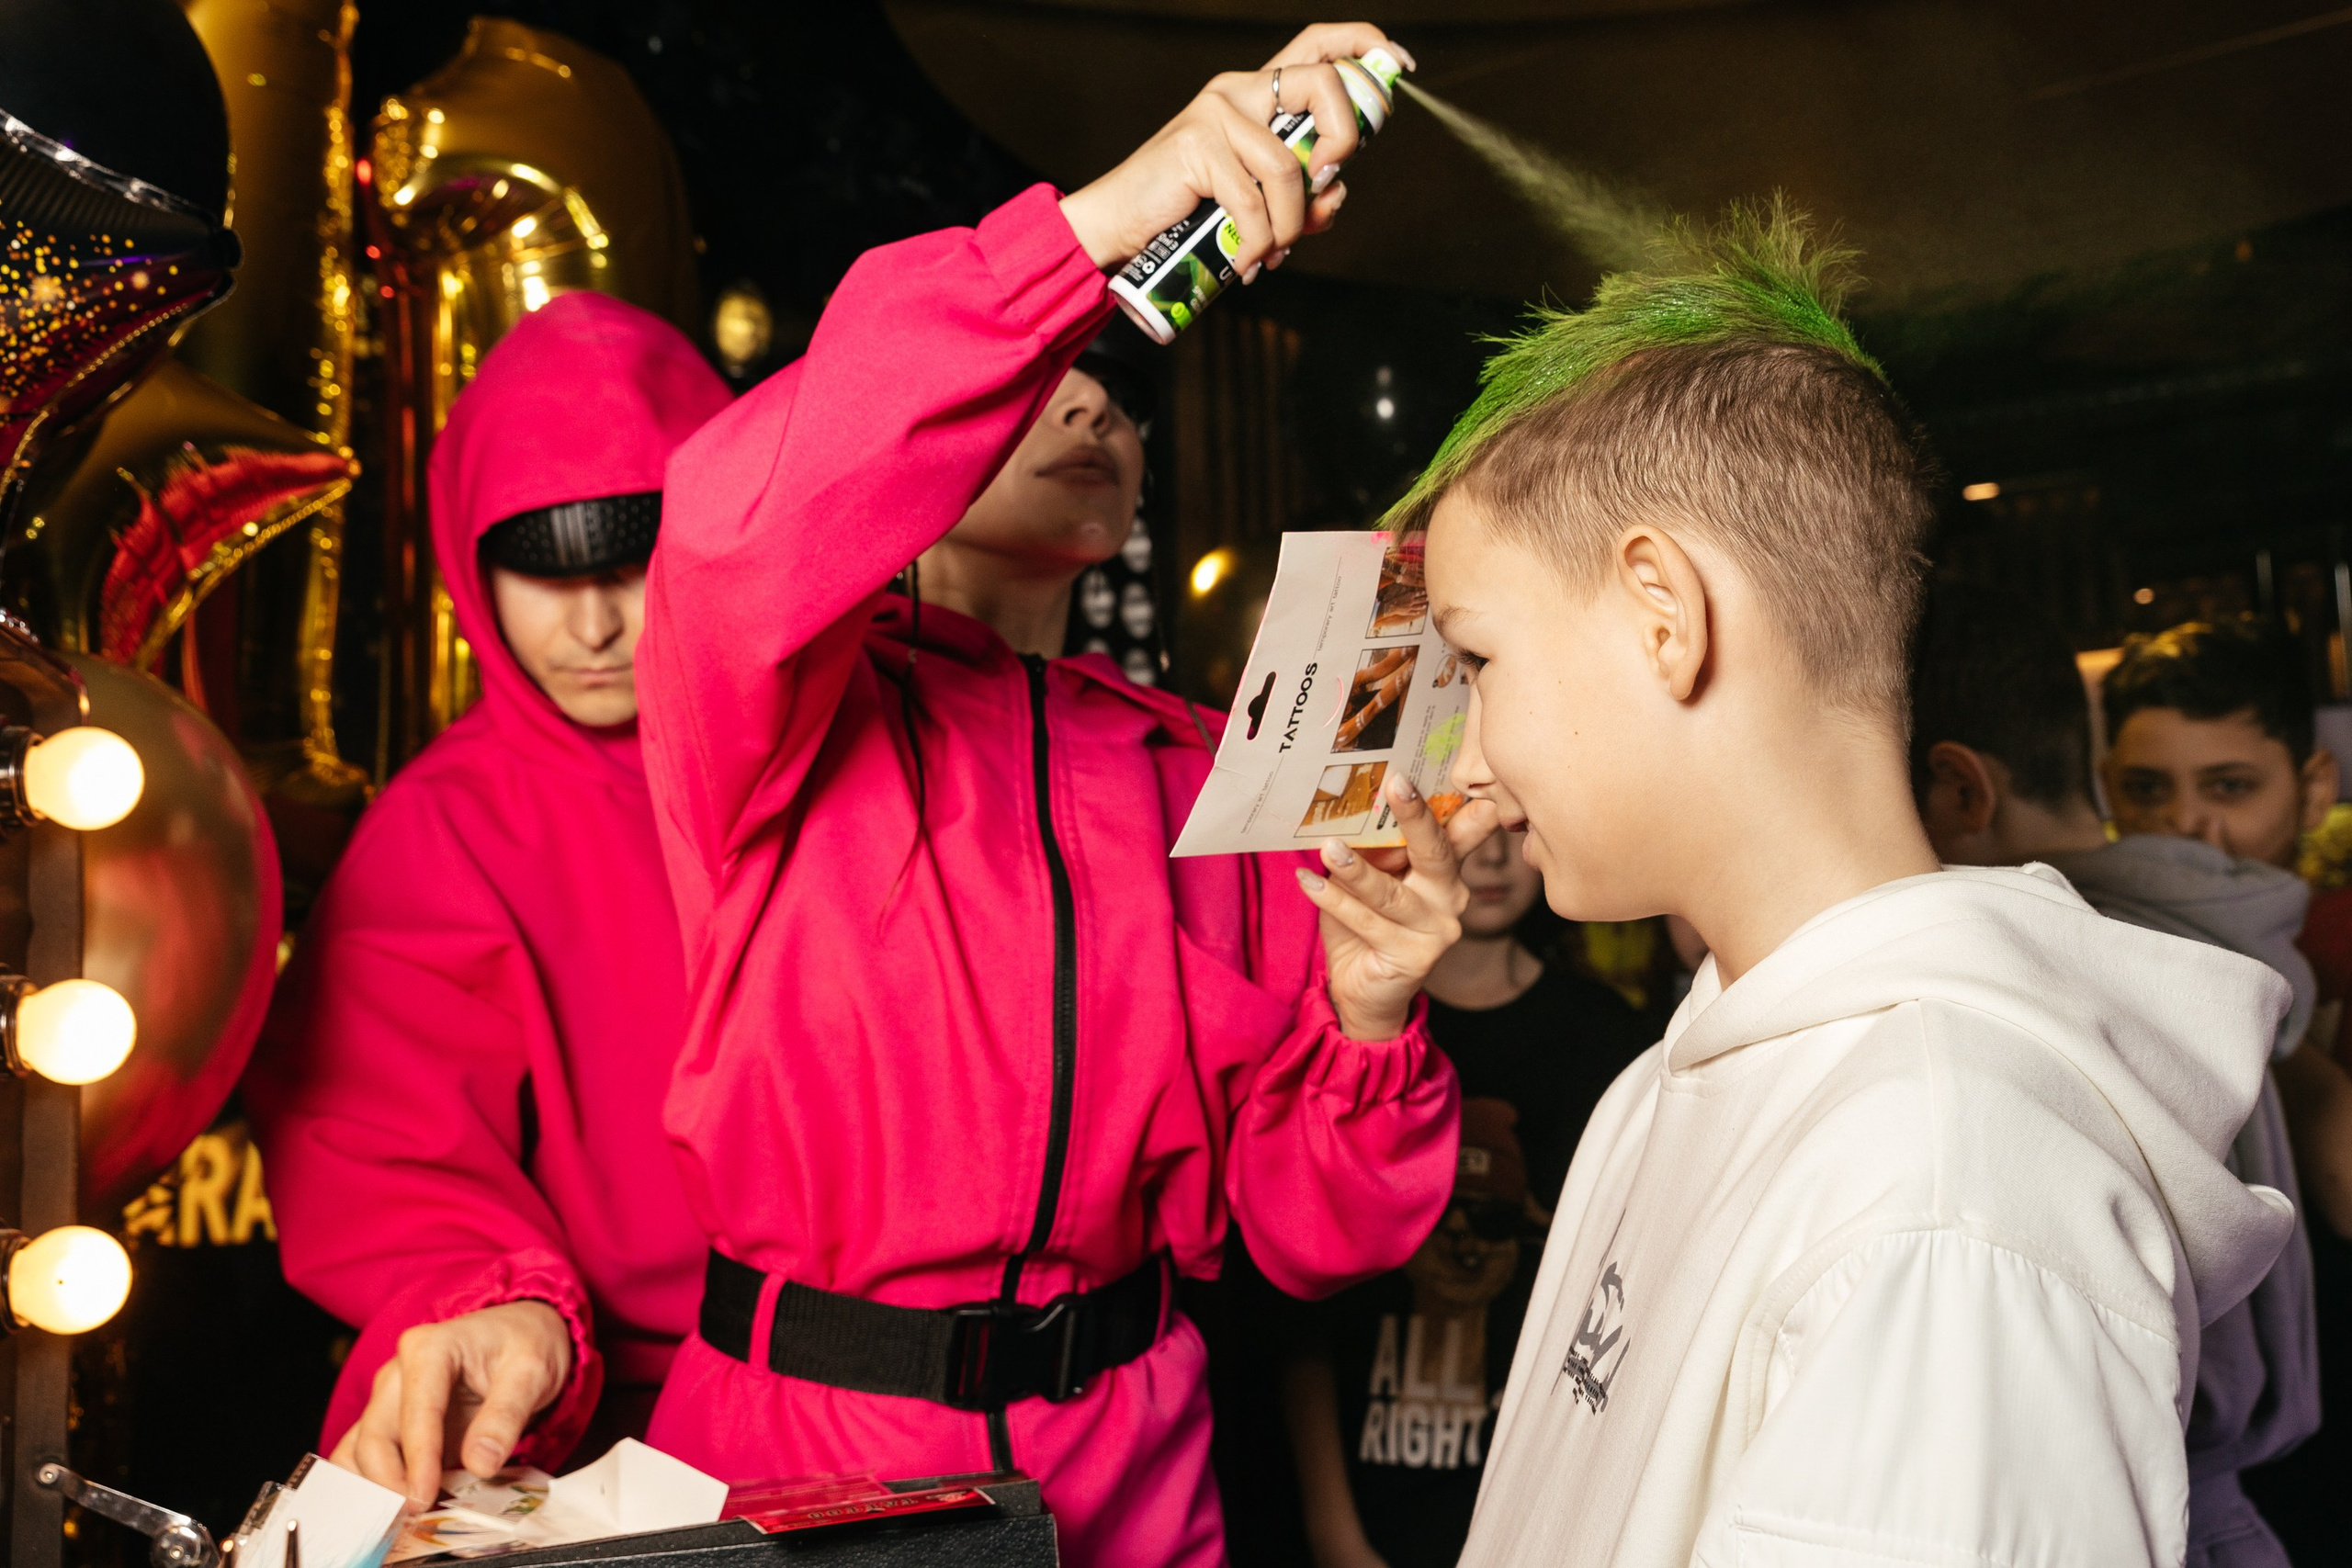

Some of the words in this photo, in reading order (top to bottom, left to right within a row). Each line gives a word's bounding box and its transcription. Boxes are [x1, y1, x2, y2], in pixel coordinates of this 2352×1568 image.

[1317, 615, 1332, 651] temporary
[1332, 576, 1341, 600] tattoo
[1279, 661, 1317, 753] TATTOOS
[1370, 1314, 1478, 1399] ALL
[1359, 1401, 1487, 1469] RIGHT
